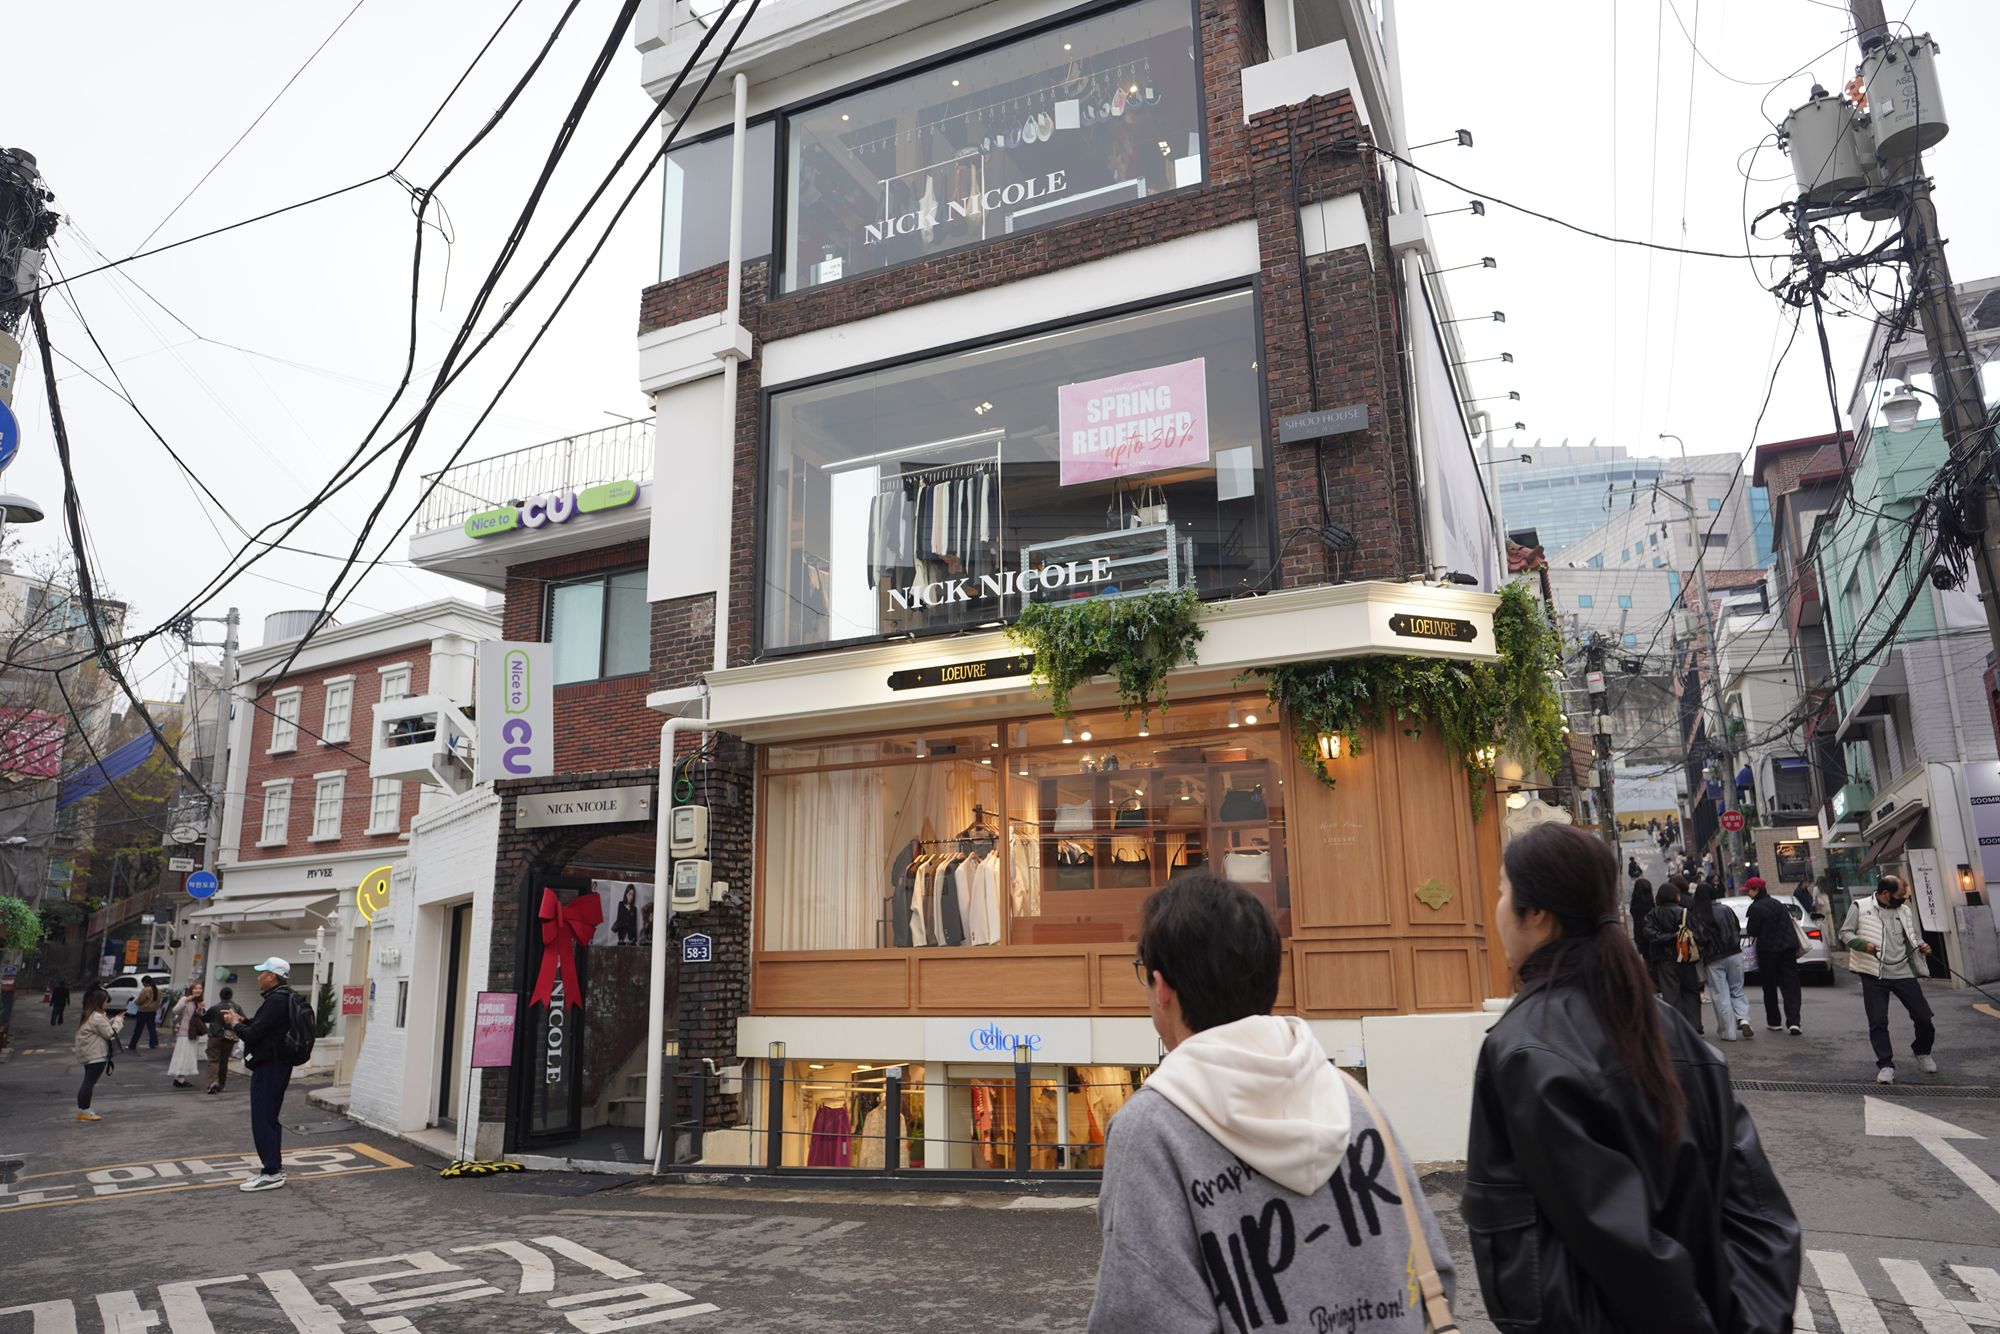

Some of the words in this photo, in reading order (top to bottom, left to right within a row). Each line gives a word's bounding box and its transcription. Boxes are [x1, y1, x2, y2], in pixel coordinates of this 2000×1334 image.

[863, 206, 940, 245] NICK
[946, 170, 1068, 222] NICOLE
[1087, 385, 1171, 423] SPRING
[1072, 411, 1191, 455] REDEFINED
[1150, 418, 1197, 450] 30%
[1285, 415, 1320, 430] SIHOO
[1322, 409, 1361, 423] HOUSE
[471, 517, 496, 531] Nice
[498, 514, 510, 526] to
[521, 491, 575, 528] CU
[887, 577, 972, 612] NICK
[979, 556, 1114, 599] NICOLE
[1410, 618, 1458, 637] LOEUVRE
[512, 660, 523, 689] Nice
[941, 663, 987, 682] LOEUVRE
[512, 690, 521, 704] to
[502, 718, 533, 774] CU
[547, 803, 574, 815] NICK
[576, 800, 617, 812] NICOLE
[687, 947, 707, 958] 58-3
[343, 995, 362, 1005] 50%
[546, 980, 564, 1084] NICOLE
